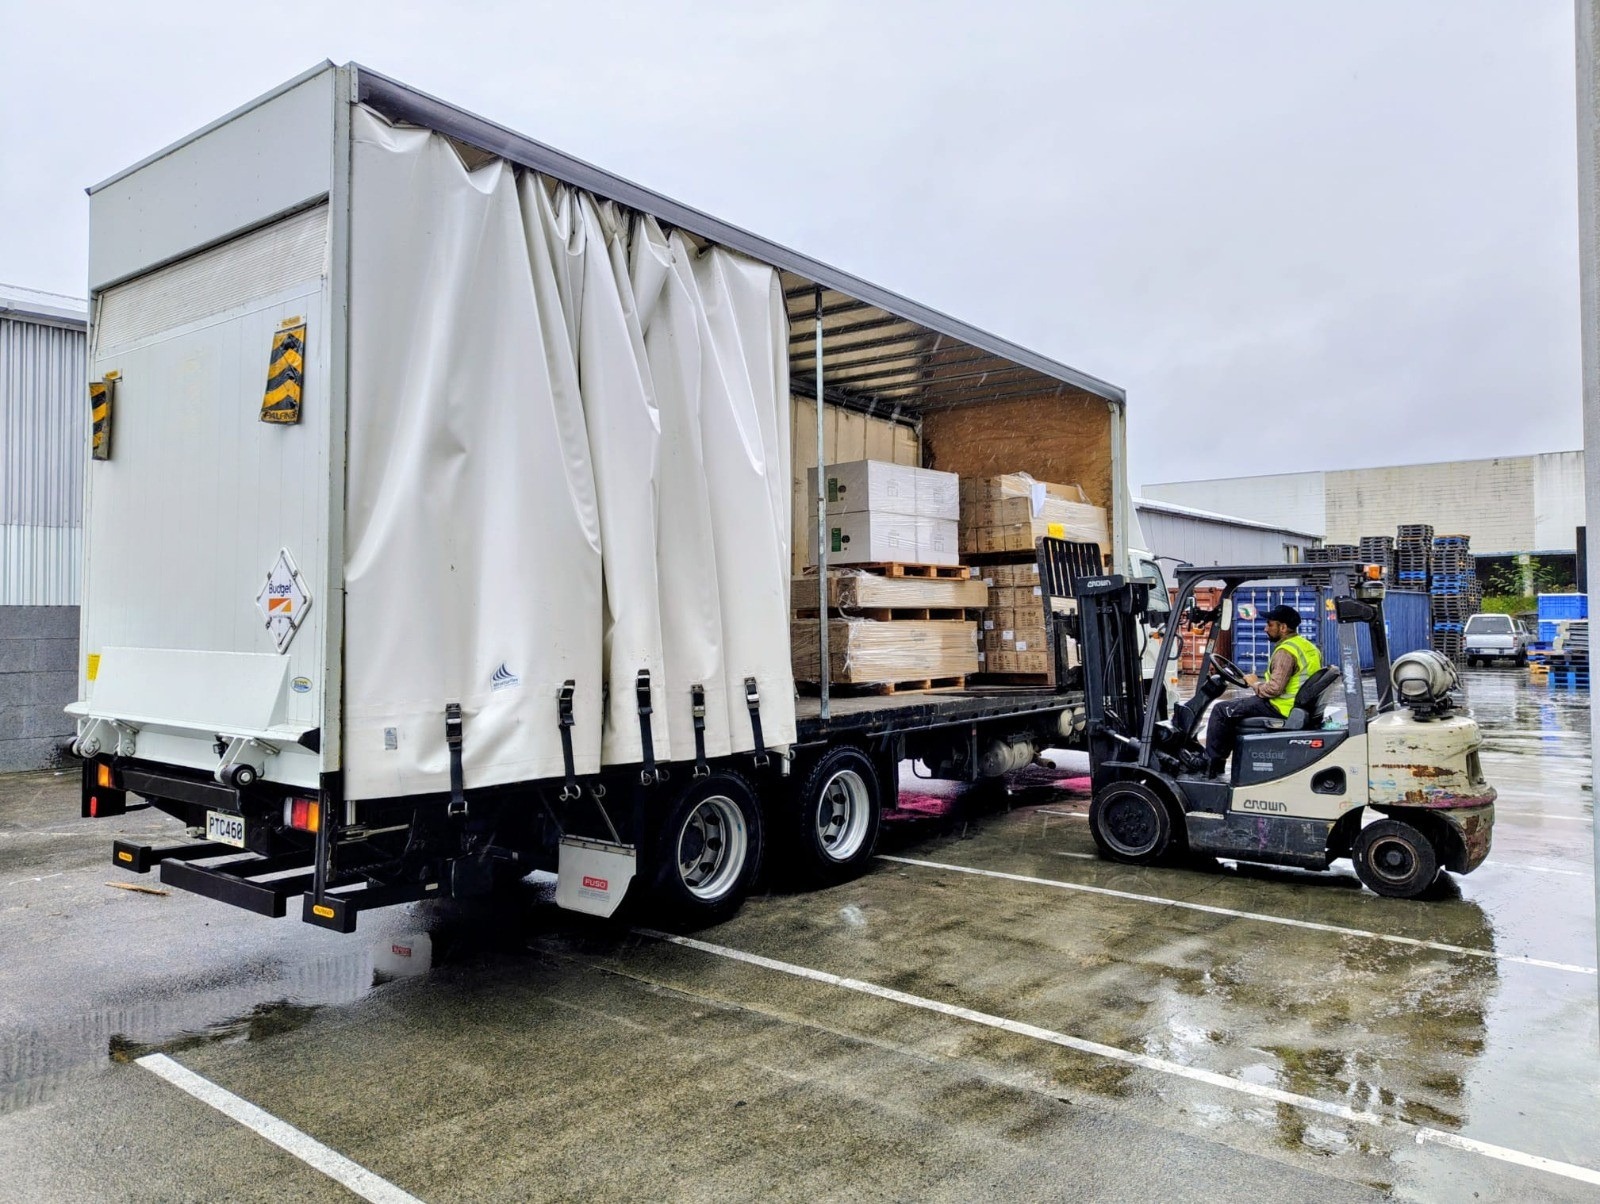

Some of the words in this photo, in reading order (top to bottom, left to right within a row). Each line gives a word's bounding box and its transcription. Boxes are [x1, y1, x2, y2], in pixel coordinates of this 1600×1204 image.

[269, 580, 291, 597] Budget
[1087, 580, 1111, 588] CROWN
[1243, 799, 1288, 812] CROWN
[209, 816, 243, 840] PTC460
[585, 878, 606, 888] FUSO
